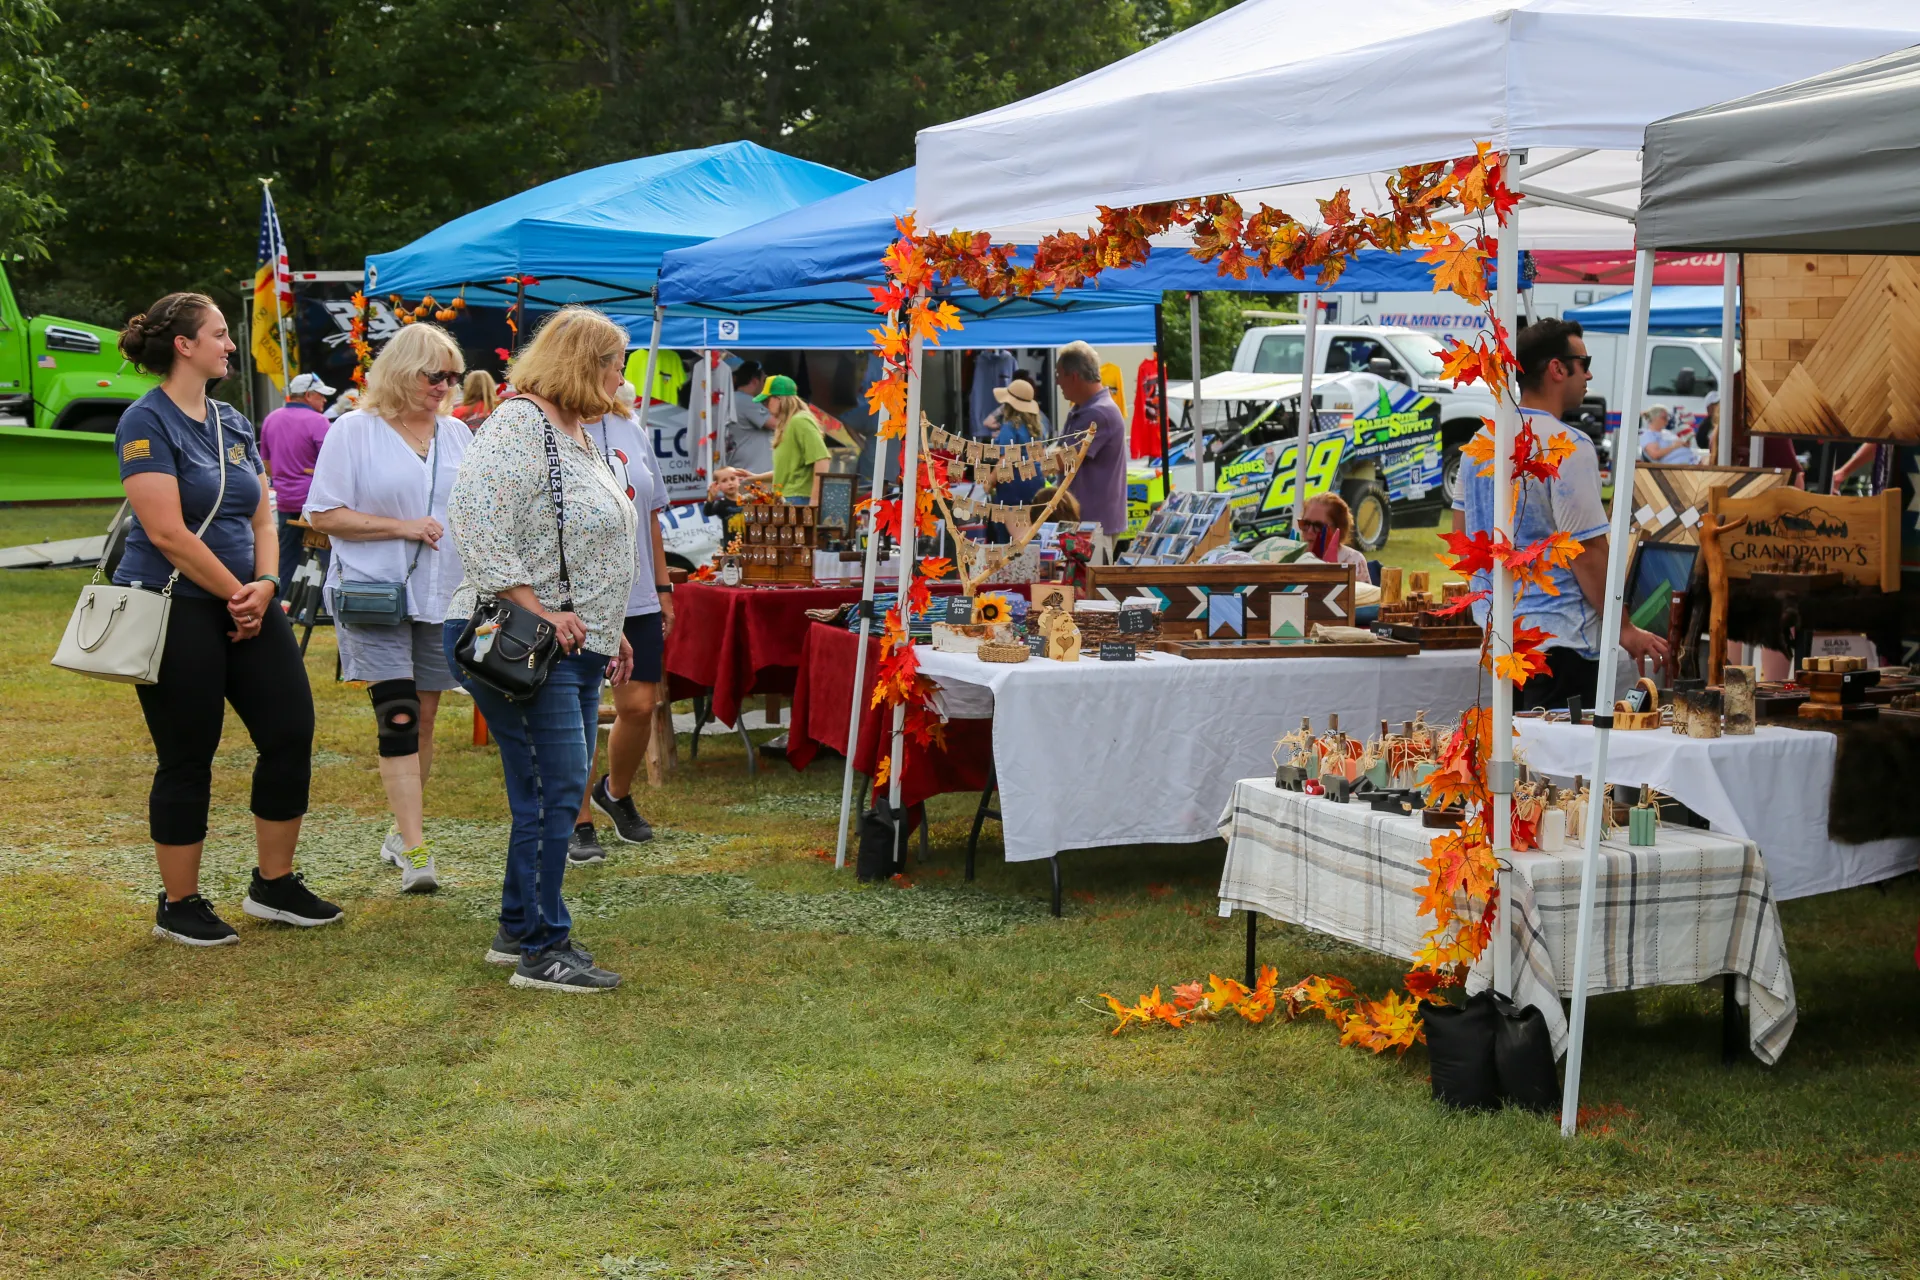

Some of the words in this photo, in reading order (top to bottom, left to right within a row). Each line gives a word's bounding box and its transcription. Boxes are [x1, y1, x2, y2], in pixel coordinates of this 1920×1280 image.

[1380, 314, 1486, 329] WILMINGTON
[1389, 414, 1433, 437] SUPPLY
[1384, 440, 1402, 450] LAWN
[1402, 434, 1434, 446] EQUIPMENT
[1222, 459, 1265, 482] FORBES
[1262, 435, 1346, 512] 29
[1730, 541, 1867, 566] GRANDPAPPY'S
[544, 962, 571, 980] N
